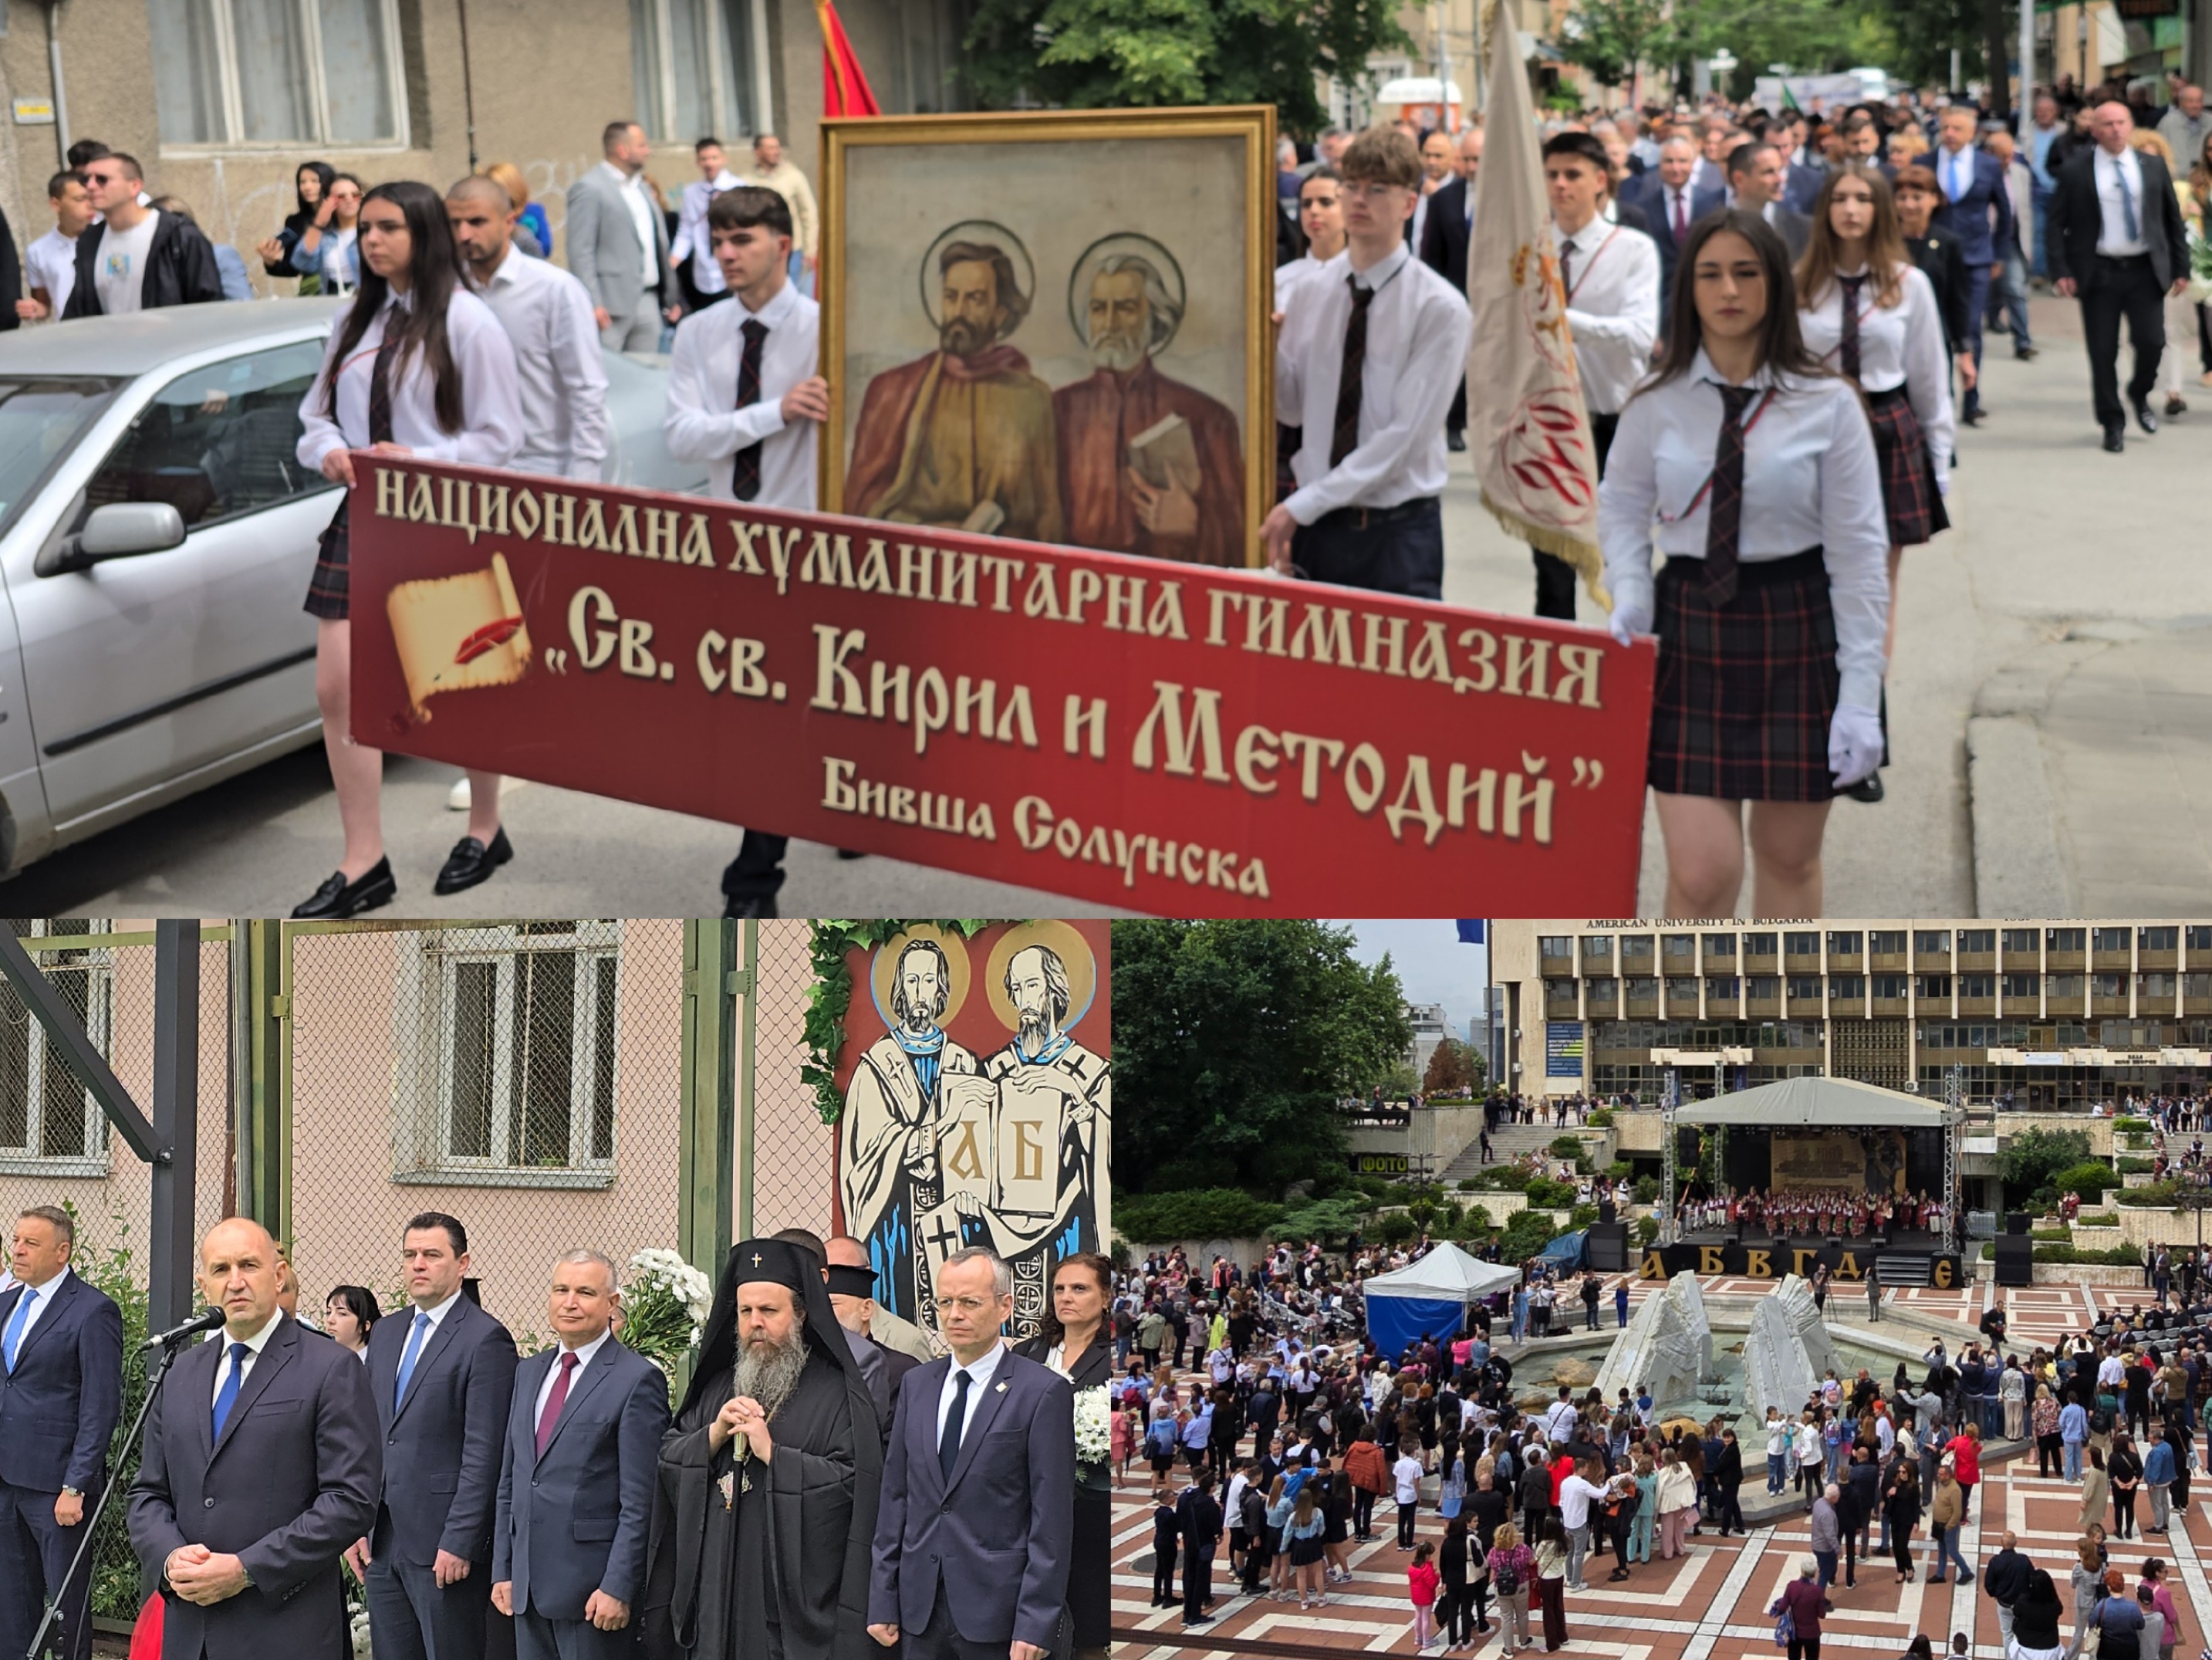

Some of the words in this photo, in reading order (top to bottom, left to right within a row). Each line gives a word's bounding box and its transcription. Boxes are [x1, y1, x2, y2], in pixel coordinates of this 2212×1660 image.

[376, 468, 715, 567] НАЦИОНАЛНА
[728, 520, 1188, 640] ХУМАНИТАРНА
[1206, 589, 1603, 708] ГИМНАЗИЯ
[697, 630, 786, 699] св.
[810, 624, 1038, 753] Кирил
[1064, 695, 1106, 758] и
[822, 756, 996, 840] Бивша
[1013, 796, 1269, 897] Солунска
[1586, 919, 1649, 928] AMERICAN
[1010, 1120, 1044, 1181] Б
[1362, 1157, 1407, 1172] ФОТО
[1640, 1250, 1667, 1280] А
[1699, 1246, 1725, 1275] Б
[1747, 1249, 1772, 1278] В
[1792, 1249, 1818, 1278] Г
[1833, 1251, 1862, 1280] Д
